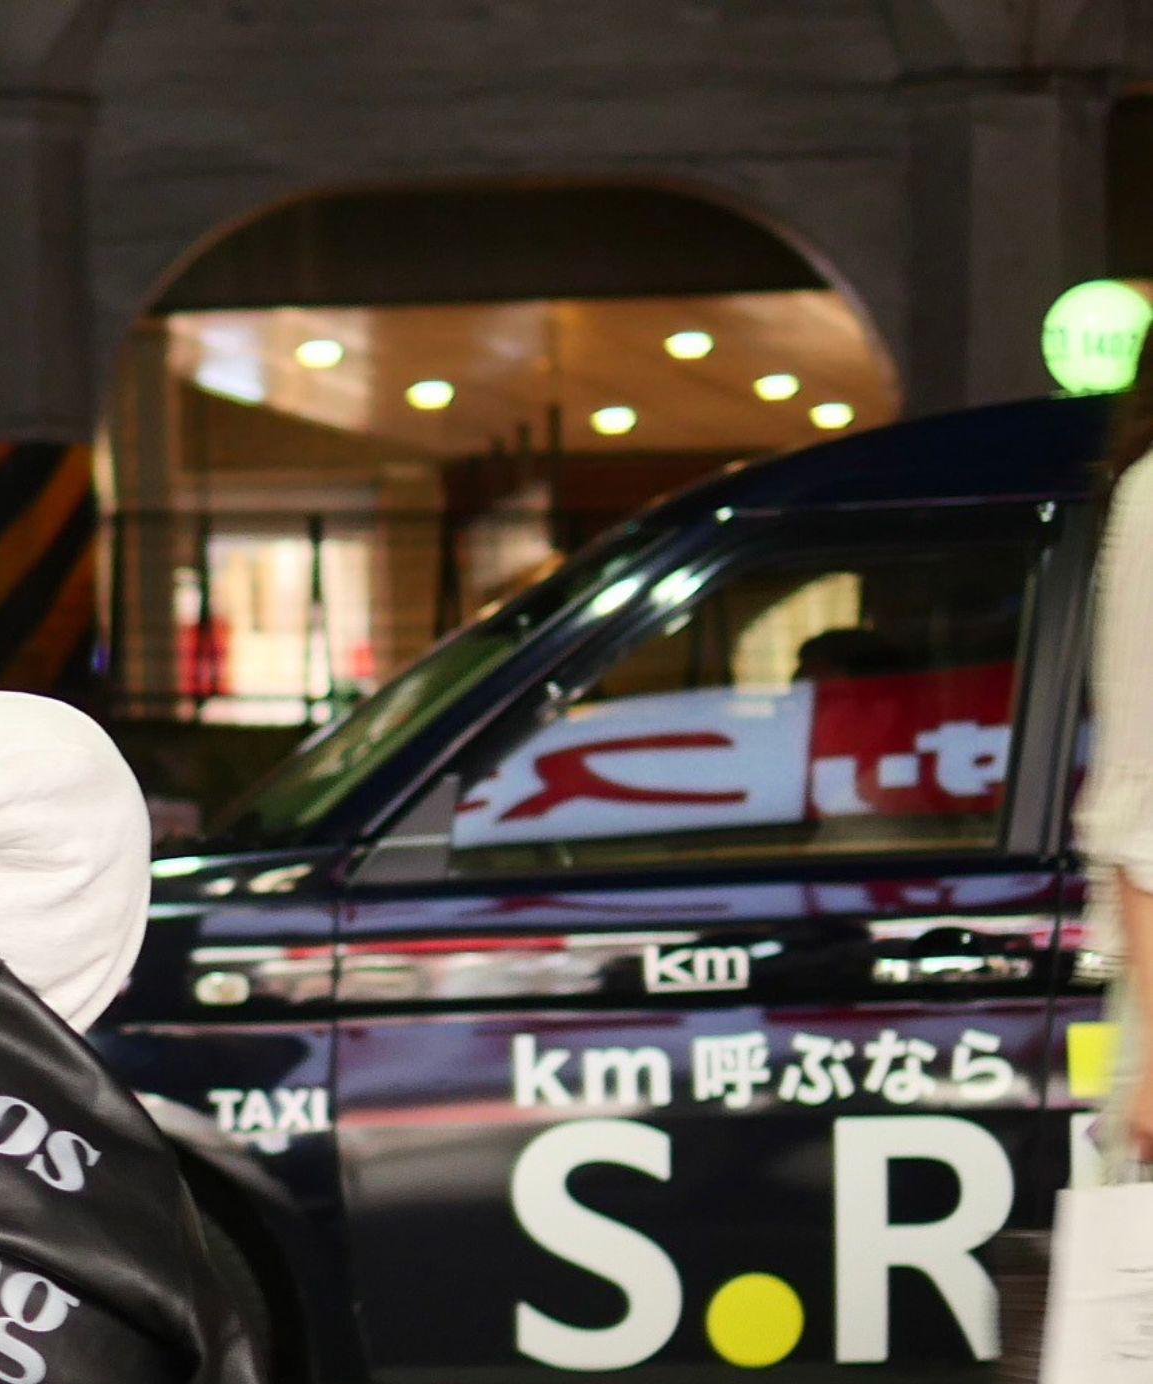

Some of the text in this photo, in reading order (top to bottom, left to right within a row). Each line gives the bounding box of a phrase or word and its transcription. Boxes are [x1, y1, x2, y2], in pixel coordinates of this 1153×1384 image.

[642, 942, 748, 993] km
[513, 1029, 1015, 1109] km 呼ぶなら
[207, 1087, 331, 1133] TAXI
